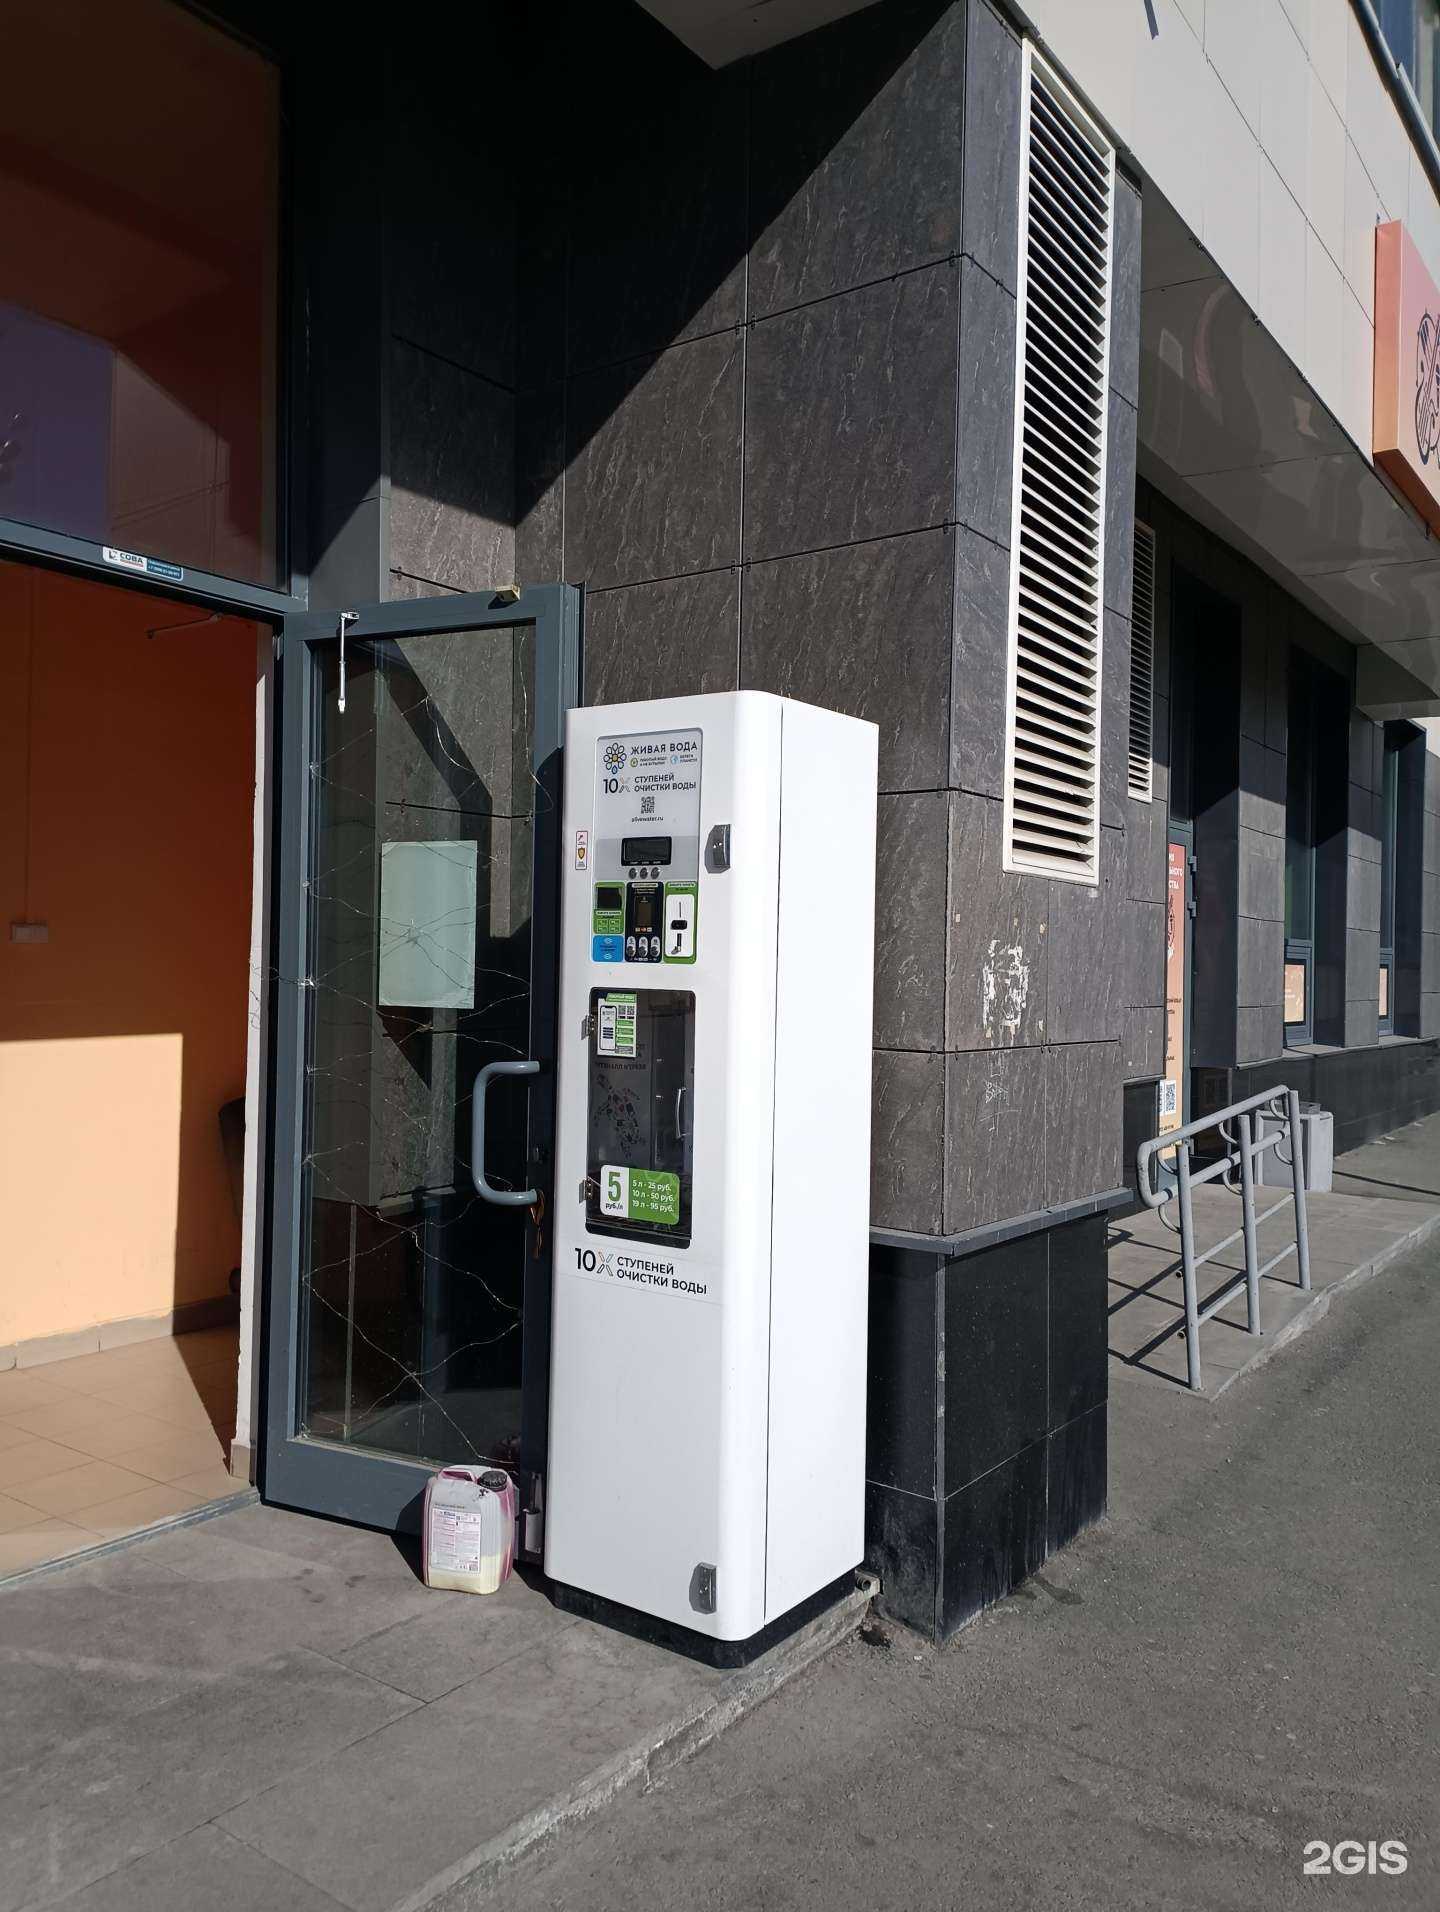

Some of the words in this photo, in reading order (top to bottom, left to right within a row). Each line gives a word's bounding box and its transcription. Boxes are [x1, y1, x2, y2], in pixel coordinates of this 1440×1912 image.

[630, 744, 666, 755] ЖИВАЯ
[669, 741, 698, 752] ВОДА
[634, 772, 675, 784] СТУПЕНЕЙ
[634, 783, 671, 793] ОЧИСТКИ
[672, 781, 697, 791] ВОДЫ
[608, 1171, 621, 1201] 5
[617, 1256, 674, 1275] СТУПЕНЕЙ
[616, 1269, 668, 1287] ОЧИСТКИ
[671, 1279, 707, 1295] ВОДЫ
